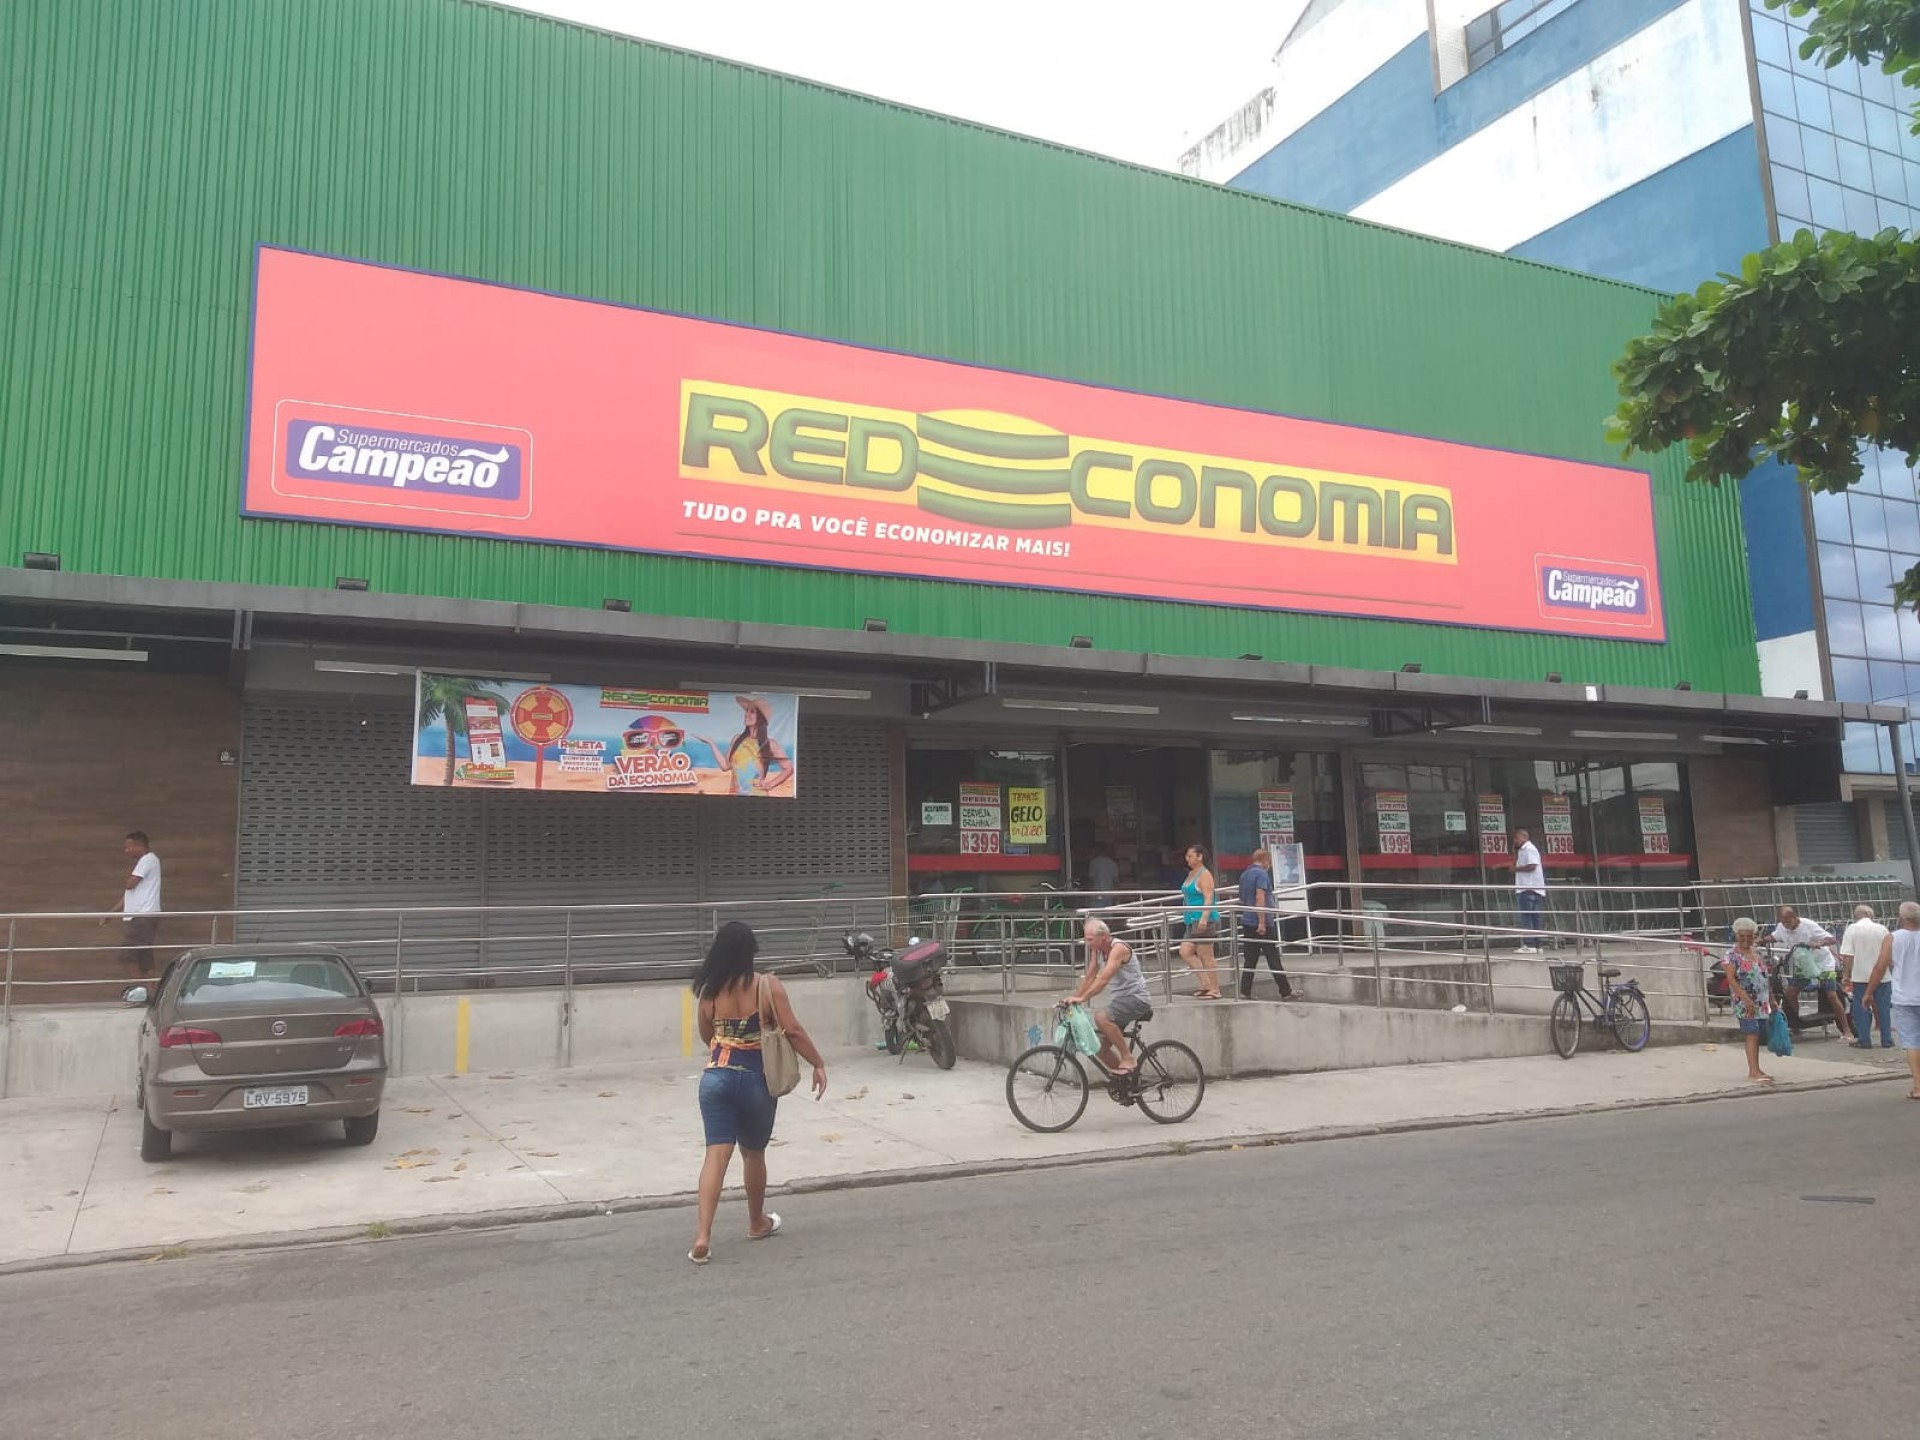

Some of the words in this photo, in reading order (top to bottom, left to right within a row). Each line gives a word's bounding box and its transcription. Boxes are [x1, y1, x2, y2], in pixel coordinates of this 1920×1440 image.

[336, 428, 461, 457] Supermercados
[298, 425, 510, 488] Campeão
[682, 500, 747, 524] TUDO
[755, 508, 802, 530] PRA
[811, 516, 868, 538] VOCÊ
[875, 522, 1010, 552] ECONOMIZAR
[1015, 537, 1071, 558] MAIS!
[1548, 569, 1640, 609] Campeão
[1562, 570, 1618, 587] Supermercados
[615, 750, 690, 774] VERÃO
[609, 775, 627, 787] DA
[629, 770, 696, 785] ECONOMIA
[1011, 805, 1043, 823] GELO
